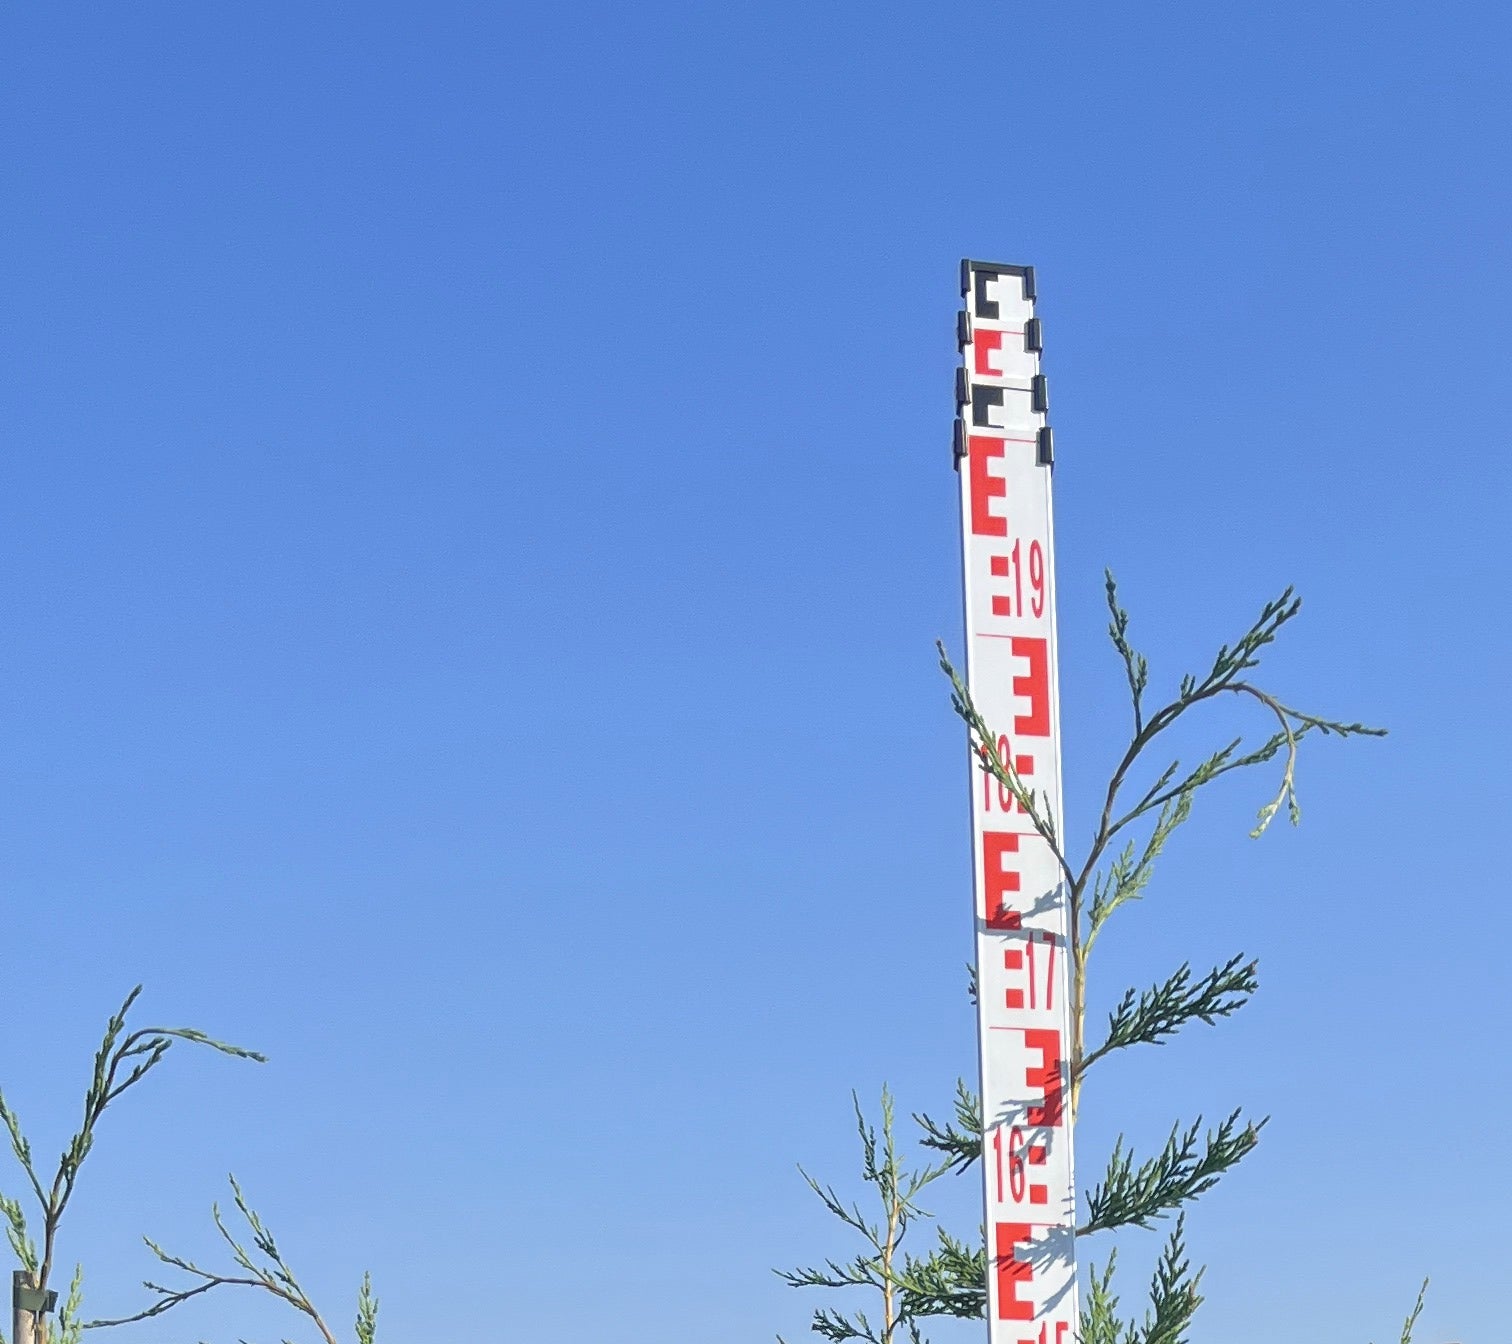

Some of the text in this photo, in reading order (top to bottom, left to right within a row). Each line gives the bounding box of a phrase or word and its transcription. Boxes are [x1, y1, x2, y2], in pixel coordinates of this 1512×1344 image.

[1011, 537, 1044, 619] 19
[1026, 930, 1056, 1011] 17
[993, 1125, 1025, 1204] 16
